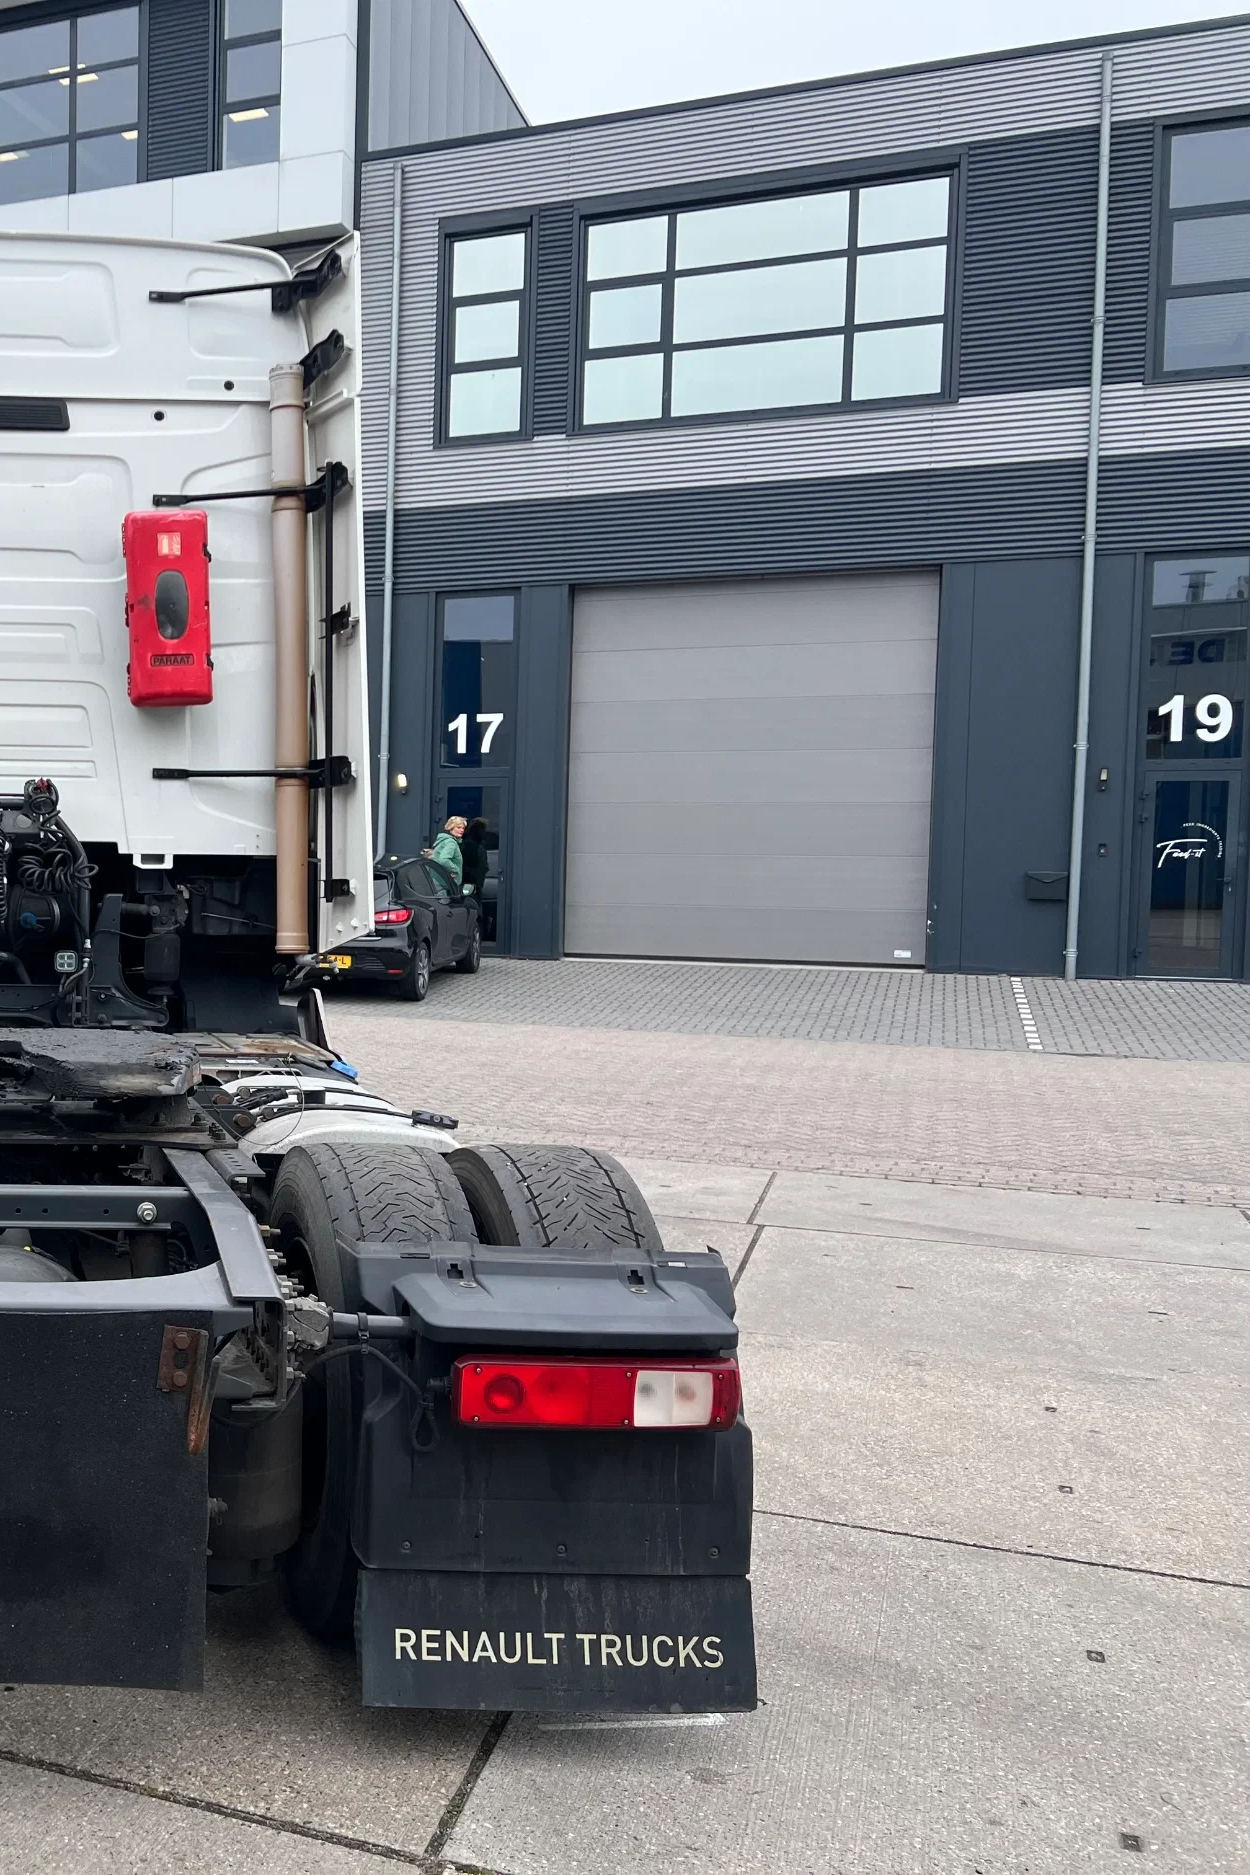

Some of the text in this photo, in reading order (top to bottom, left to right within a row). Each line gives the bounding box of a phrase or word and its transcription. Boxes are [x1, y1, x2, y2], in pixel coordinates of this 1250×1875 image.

[153, 655, 191, 666] PARAAT
[448, 713, 504, 754] 17
[1157, 693, 1233, 742] 19
[394, 1628, 725, 1668] RENAULT TRUCKS
